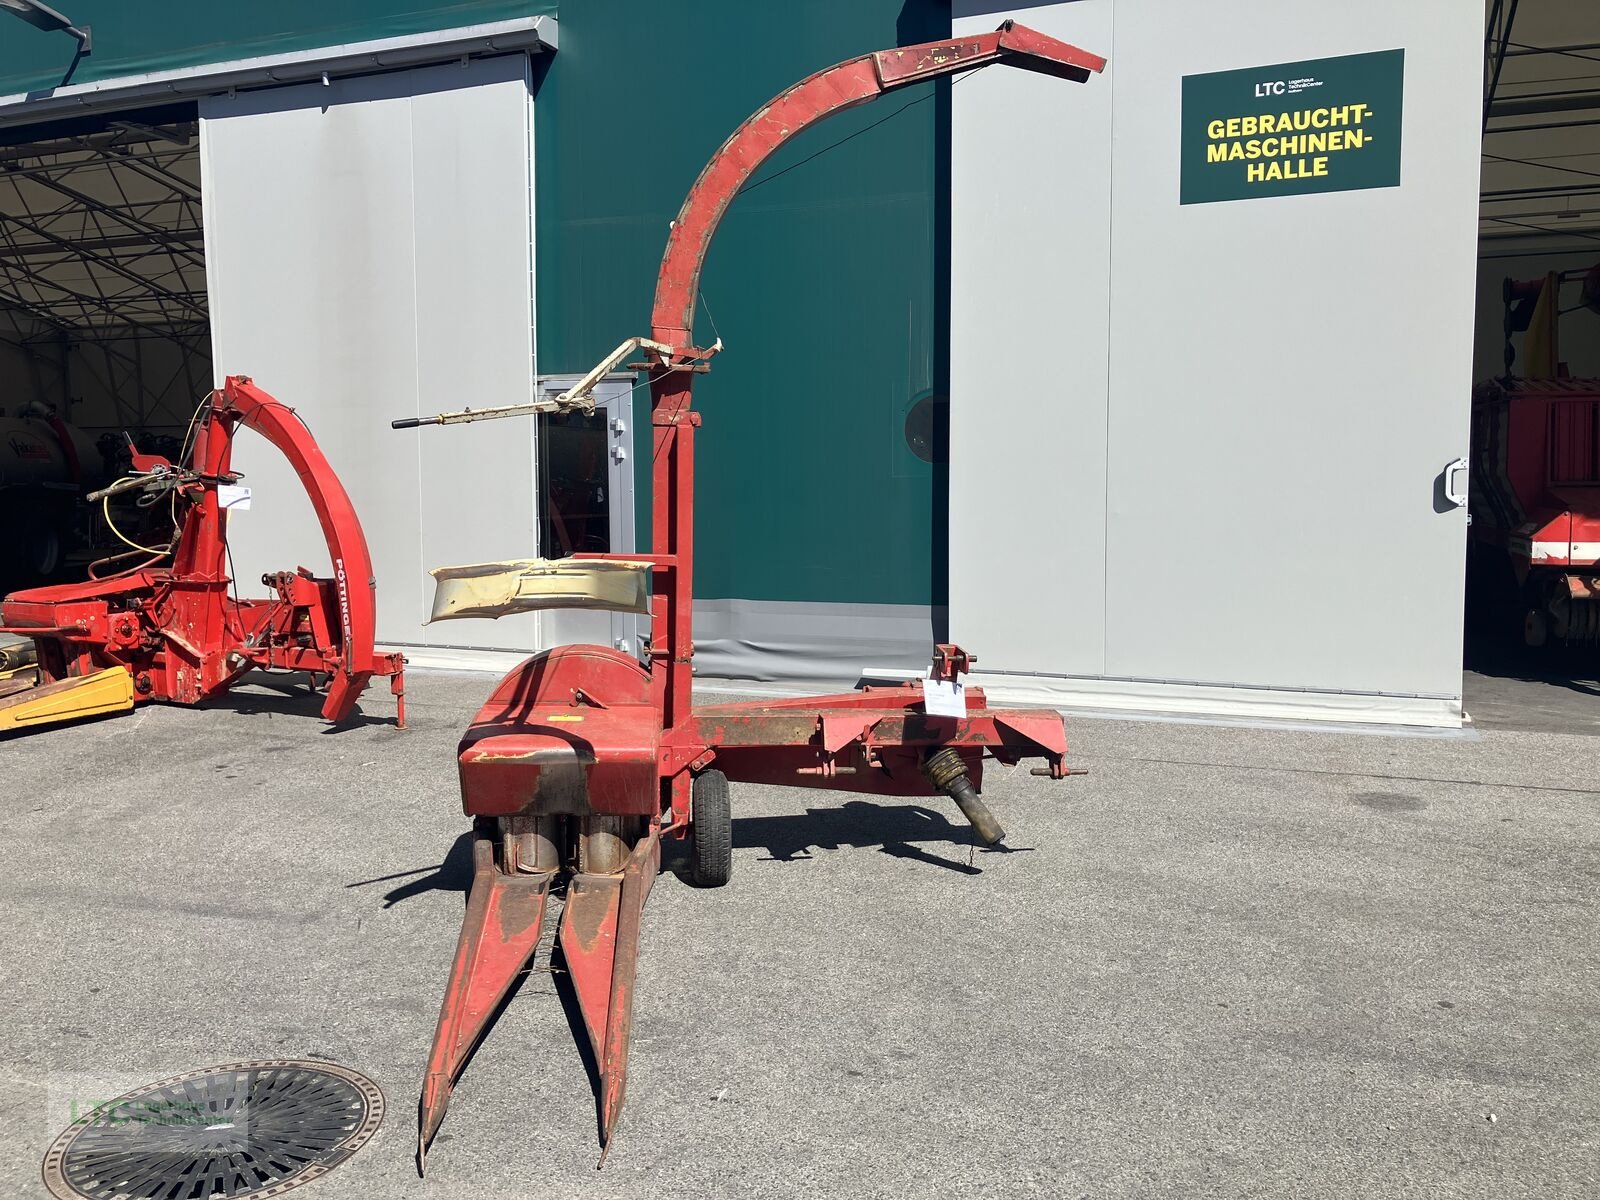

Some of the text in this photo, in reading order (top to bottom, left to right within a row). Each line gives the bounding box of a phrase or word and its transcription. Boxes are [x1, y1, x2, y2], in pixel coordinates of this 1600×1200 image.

[1255, 81, 1286, 97] LTC
[1207, 103, 1373, 140] GEBRAUCHT-
[1207, 128, 1373, 163] MASCHINEN-
[1247, 156, 1329, 183] HALLE
